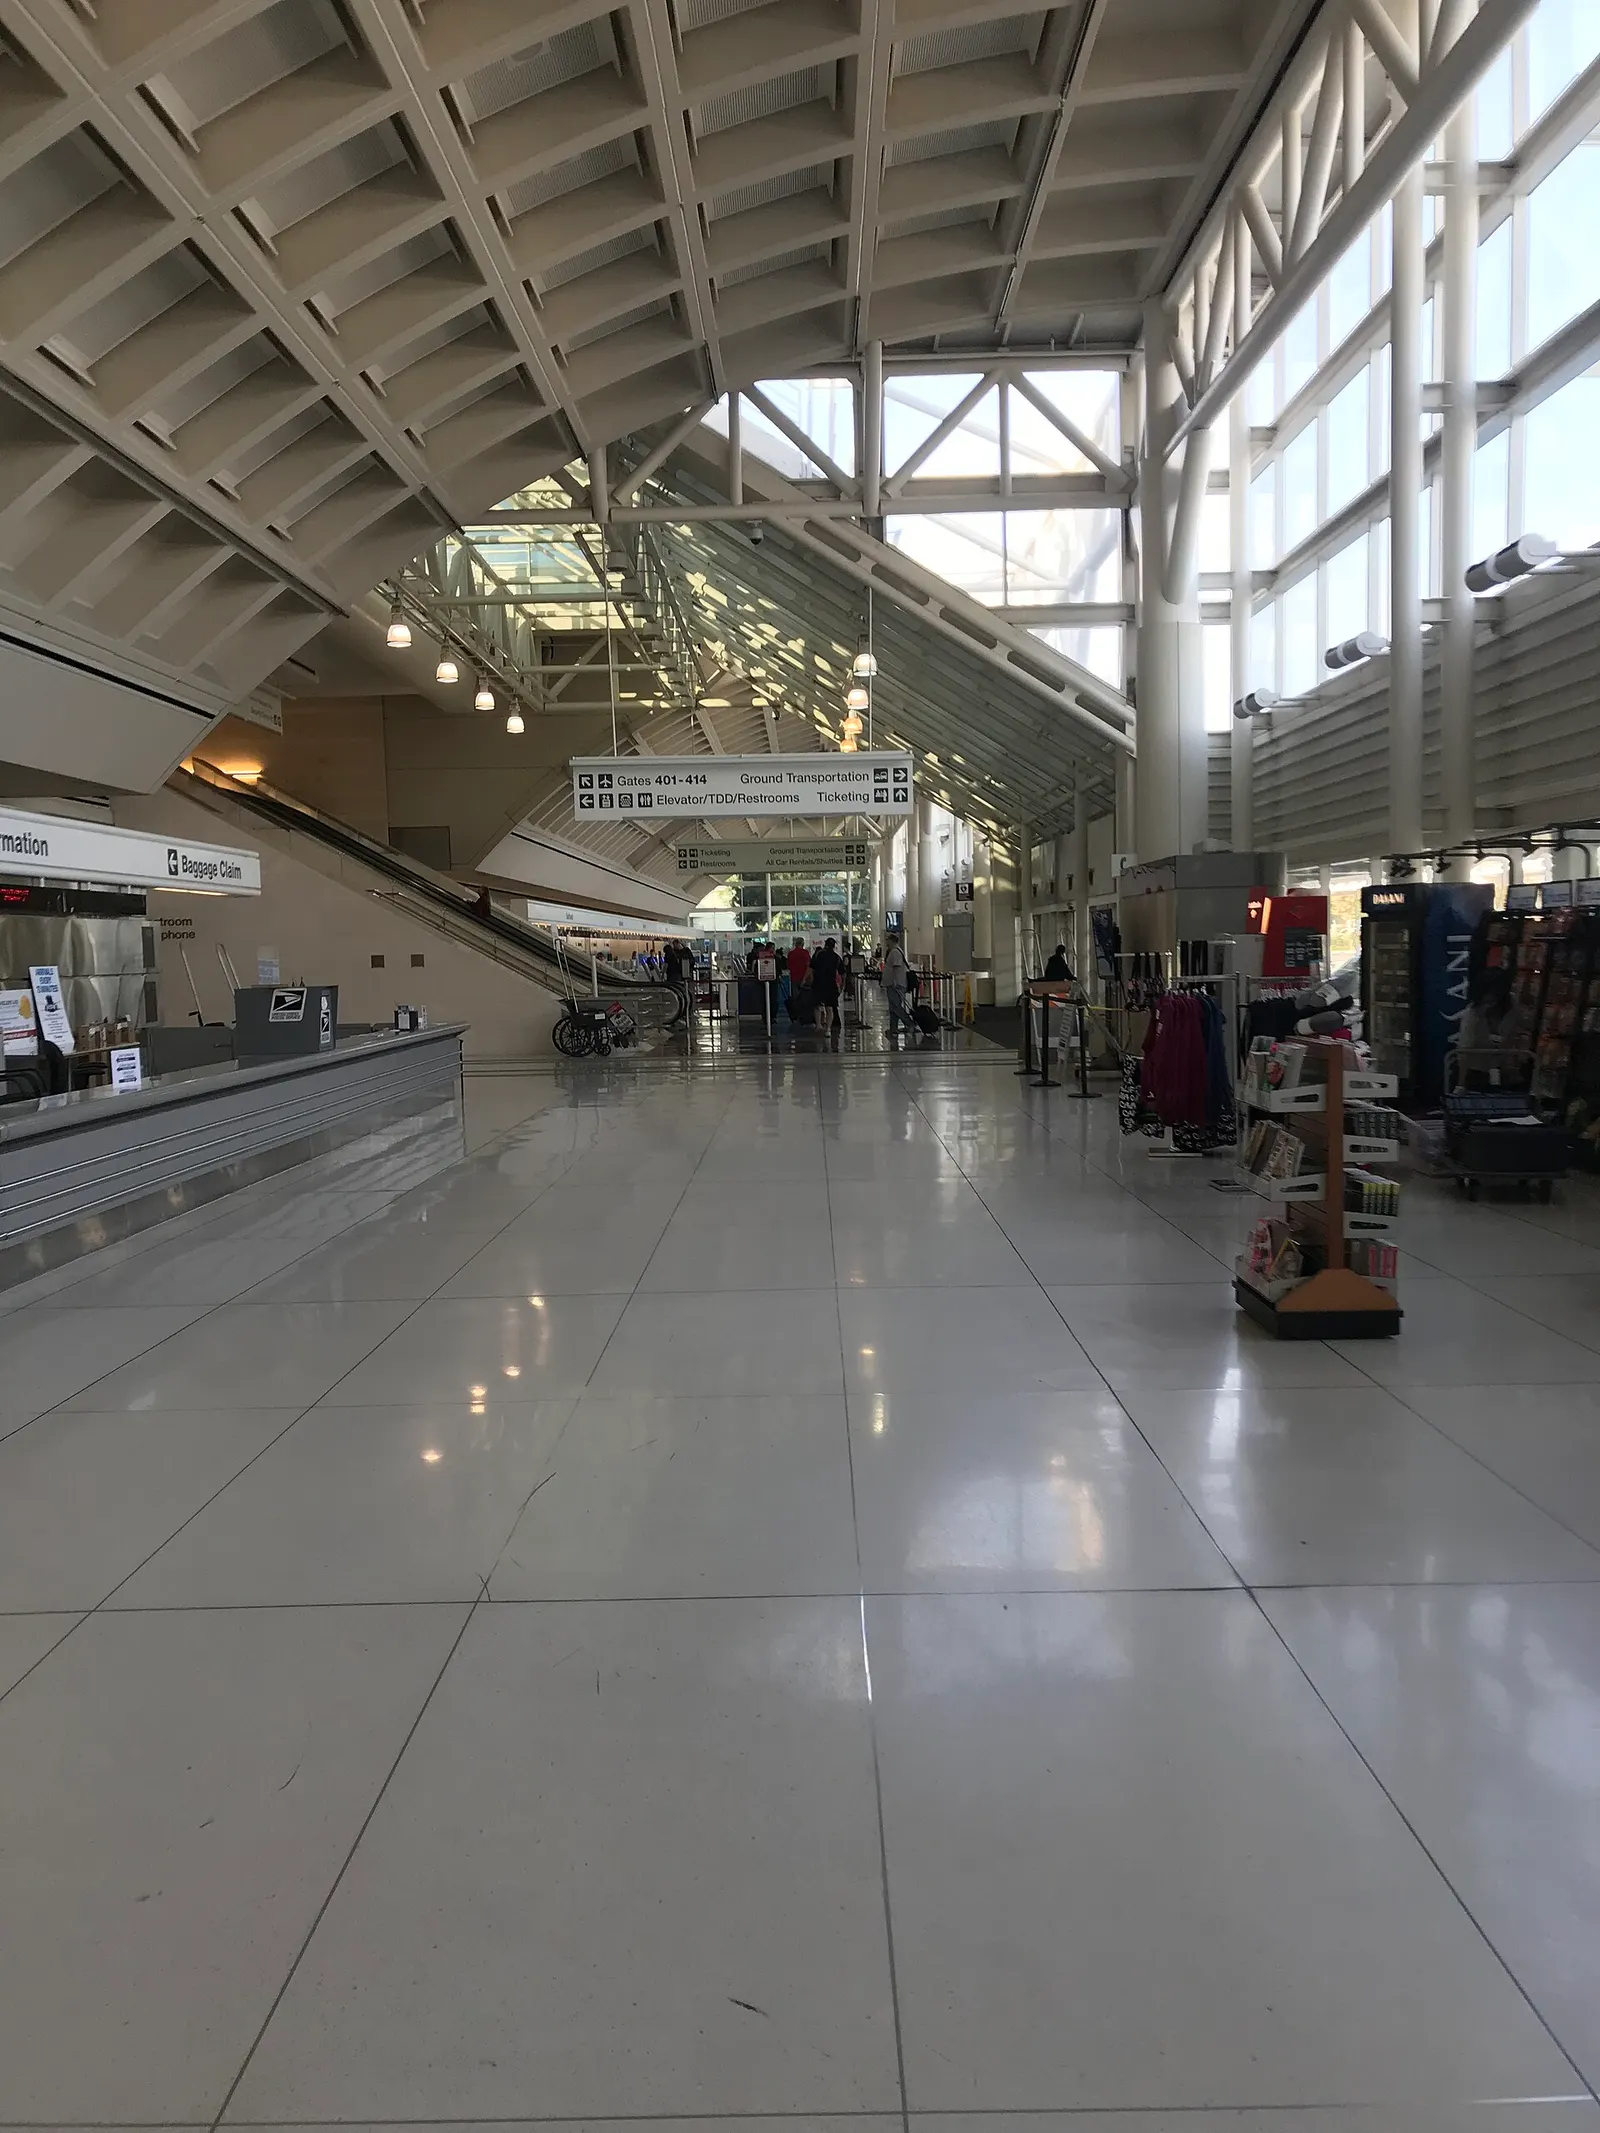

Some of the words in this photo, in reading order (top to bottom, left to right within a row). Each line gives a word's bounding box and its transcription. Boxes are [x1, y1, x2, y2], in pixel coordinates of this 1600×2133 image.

[617, 776, 651, 786] Gates
[655, 774, 707, 785] 401-414
[740, 773, 783, 784] Ground
[786, 771, 870, 785] Transportation
[656, 793, 800, 805] Elevator/TDD/Restrooms
[817, 791, 870, 804] Ticketing
[701, 849, 731, 857] Ticketing
[769, 847, 795, 855] Ground
[796, 846, 844, 855] Transportation
[181, 855, 218, 880] Baggage
[219, 860, 242, 880] Claim
[700, 860, 737, 868] Restrooms
[161, 930, 196, 941] phone
